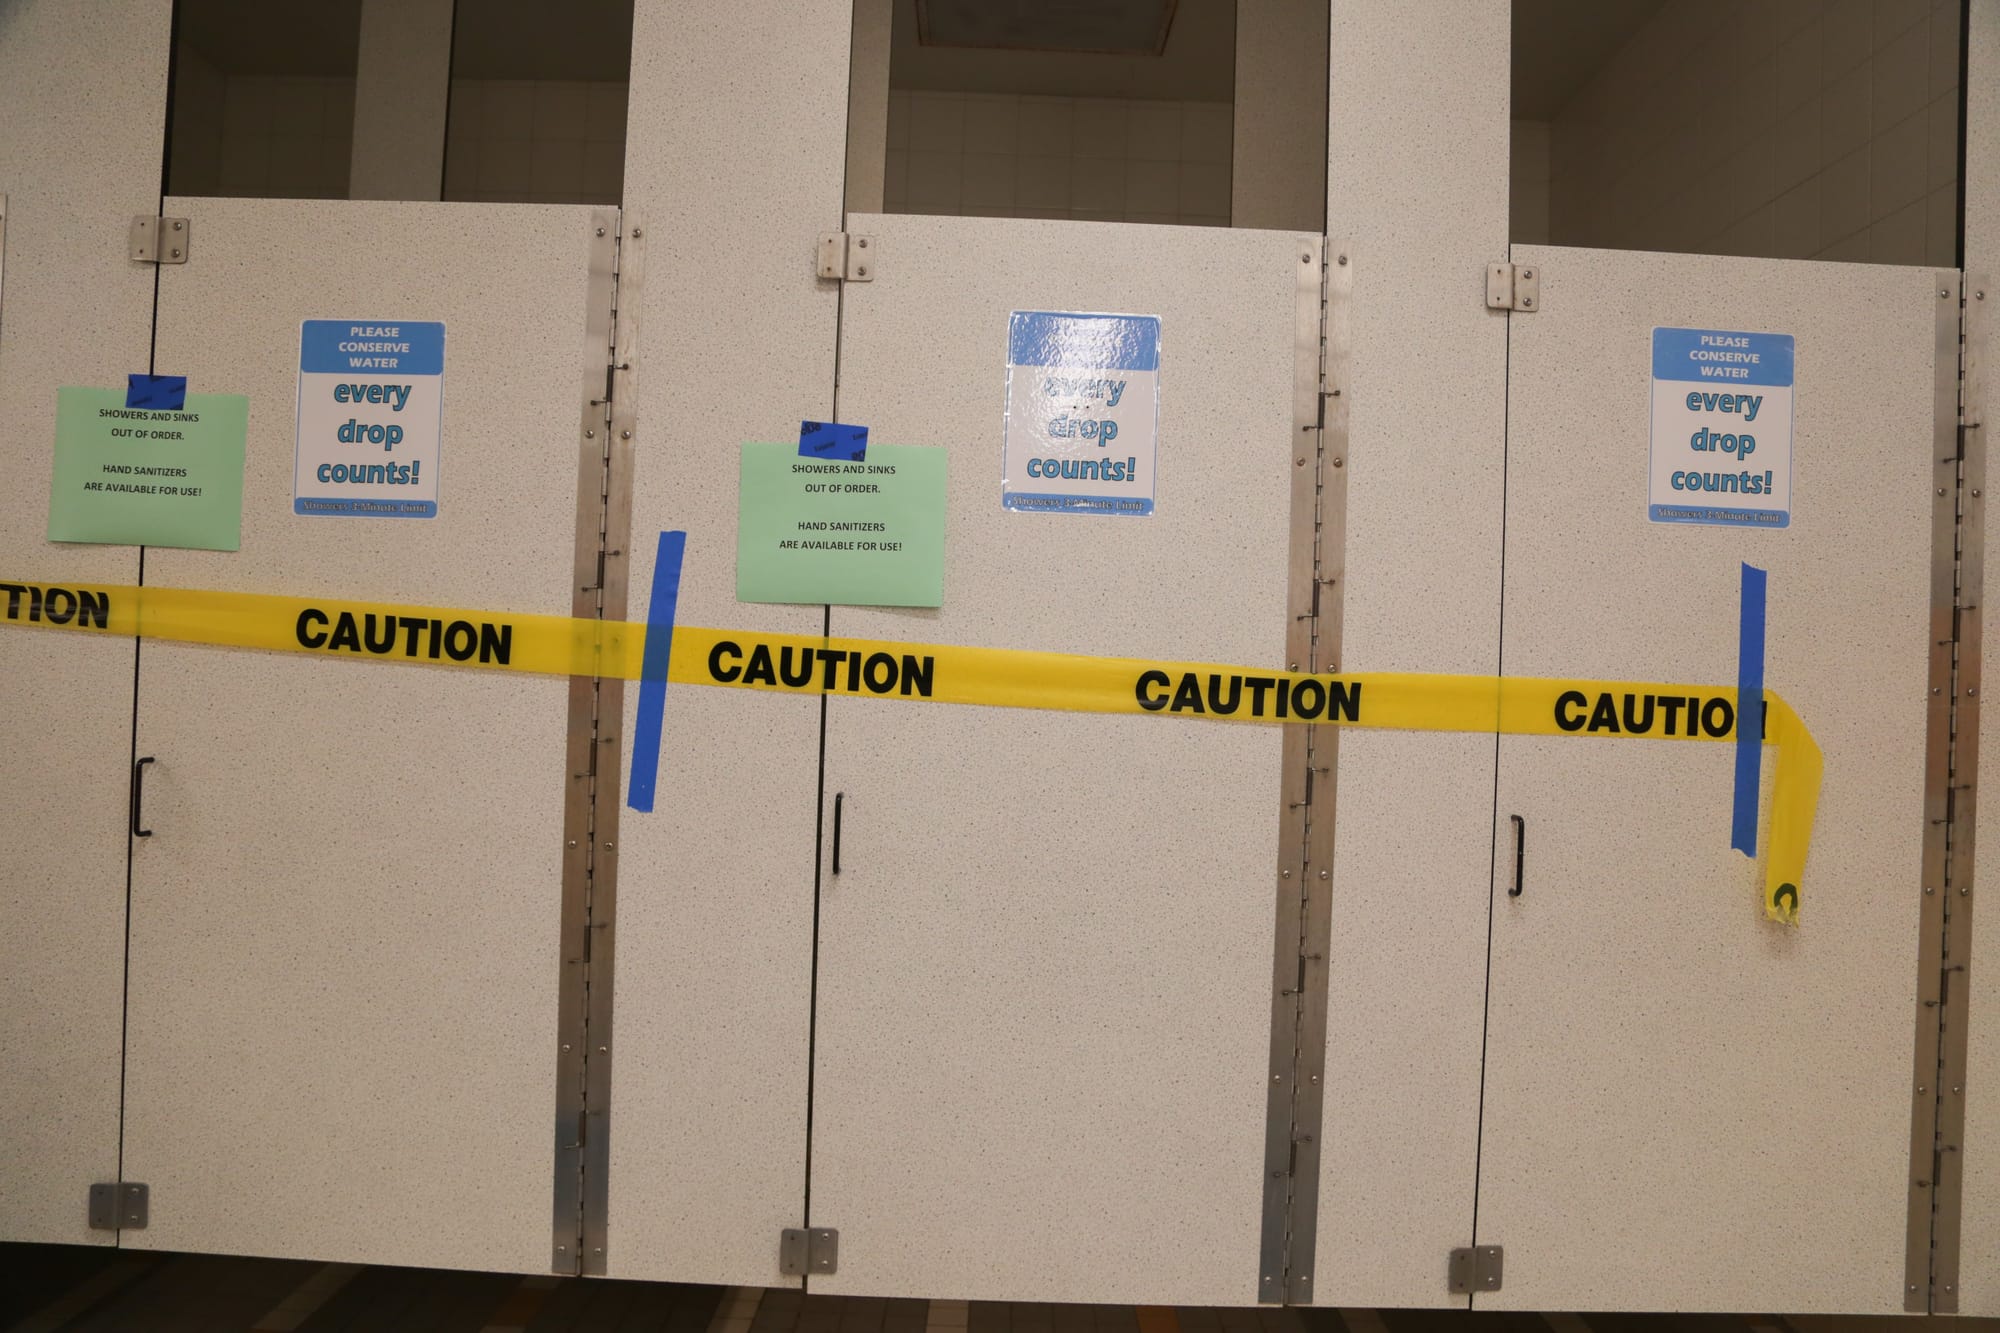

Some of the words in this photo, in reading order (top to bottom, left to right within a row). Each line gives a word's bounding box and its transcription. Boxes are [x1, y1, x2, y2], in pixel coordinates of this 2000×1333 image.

[350, 327, 399, 337] PLEASE
[339, 342, 409, 353] CONSERVE
[1701, 336, 1750, 347] PLEASE
[349, 357, 398, 368] WATER
[1689, 351, 1760, 363] CONSERVE
[1701, 366, 1749, 378] WATER
[334, 383, 412, 411] every
[1044, 376, 1126, 406] every
[1686, 392, 1763, 421] every
[99, 409, 148, 420] SHOWERS
[151, 412, 171, 421] AND
[173, 412, 199, 422] SINKS
[111, 428, 133, 438] OUT
[135, 430, 149, 438] OF
[151, 431, 185, 440] ORDER.
[338, 419, 403, 451] drop
[1048, 414, 1118, 447] drop
[1691, 428, 1755, 460] drop
[103, 465, 132, 474] HAND
[134, 466, 187, 477] SANITIZERS
[317, 461, 420, 484] counts!
[792, 464, 840, 474] SHOWERS
[843, 465, 865, 474] AND
[868, 465, 895, 474] SINKS
[1027, 457, 1136, 481] counts!
[1671, 470, 1773, 494] counts!
[84, 483, 103, 491] ARE
[105, 484, 156, 494] AVAILABLE
[159, 487, 177, 495] FOR
[180, 487, 202, 496] USE!
[805, 484, 826, 493] OUT
[829, 484, 842, 492] OF
[844, 484, 880, 493] ORDER.
[798, 522, 827, 530] HAND
[829, 522, 885, 531] SANITIZERS
[779, 541, 798, 549] ARE
[801, 541, 854, 550] AVAILABLE
[857, 542, 876, 550] FOR
[879, 543, 902, 551] USE!
[295, 607, 513, 665] CAUTION
[706, 640, 935, 698] CAUTION
[1134, 670, 1361, 723] CAUTION
